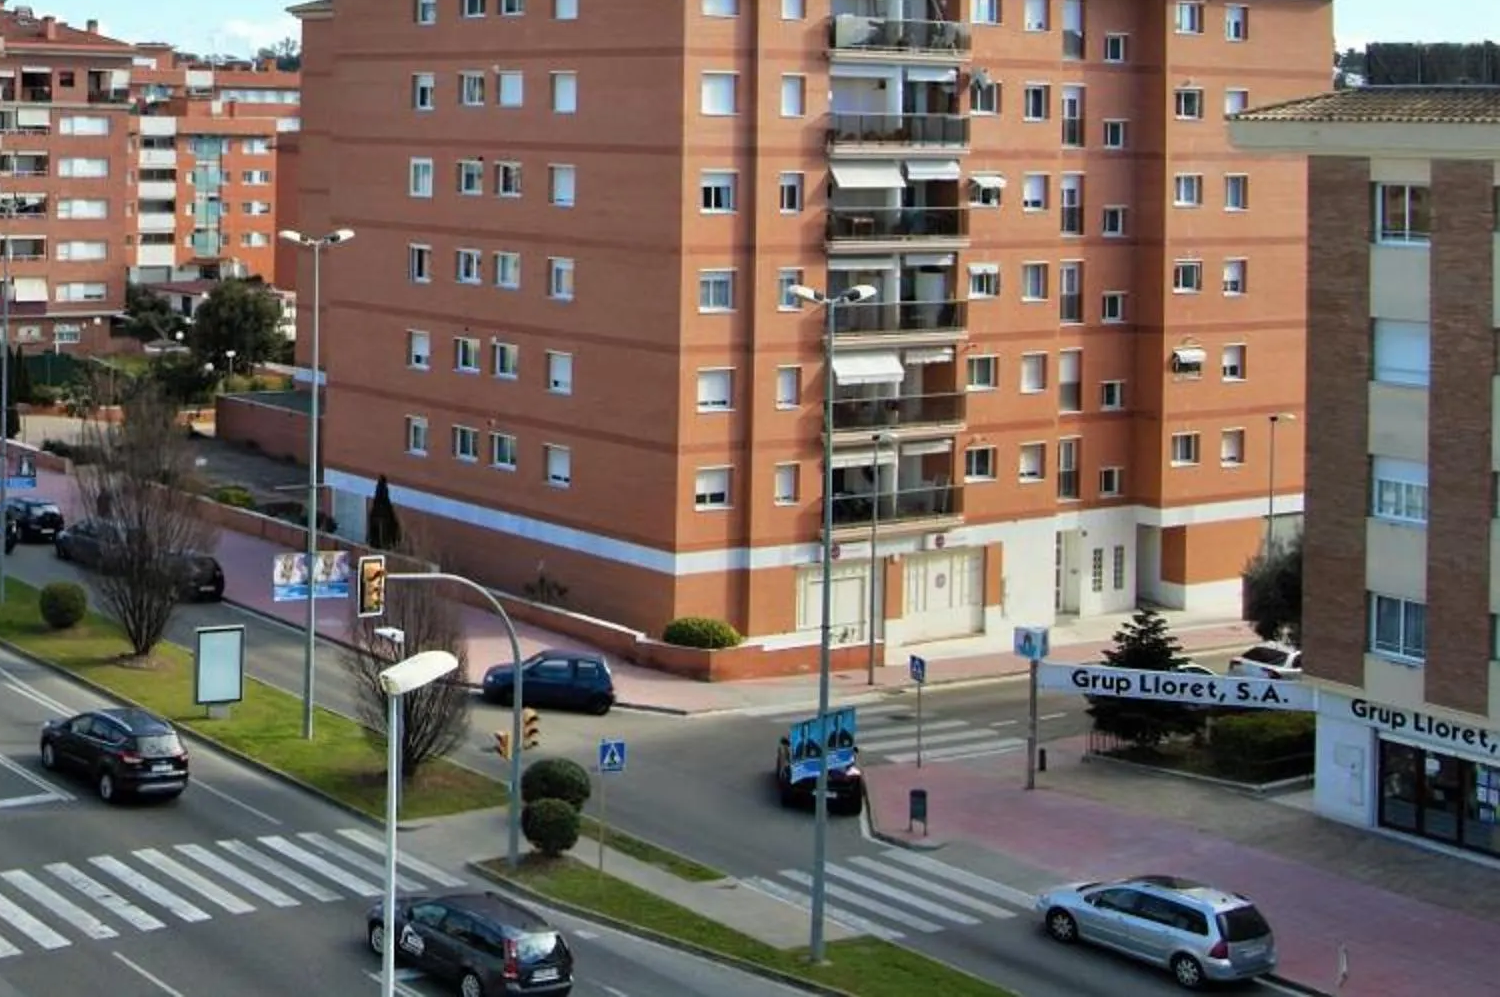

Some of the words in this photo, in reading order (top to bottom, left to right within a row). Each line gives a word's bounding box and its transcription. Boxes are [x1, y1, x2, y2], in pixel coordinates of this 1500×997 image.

[1071, 669, 1132, 694] Grup
[1139, 674, 1226, 702] Lloret,
[1236, 682, 1289, 703] S.A.
[1351, 698, 1407, 729] Grup
[1413, 712, 1498, 754] Lloret,
